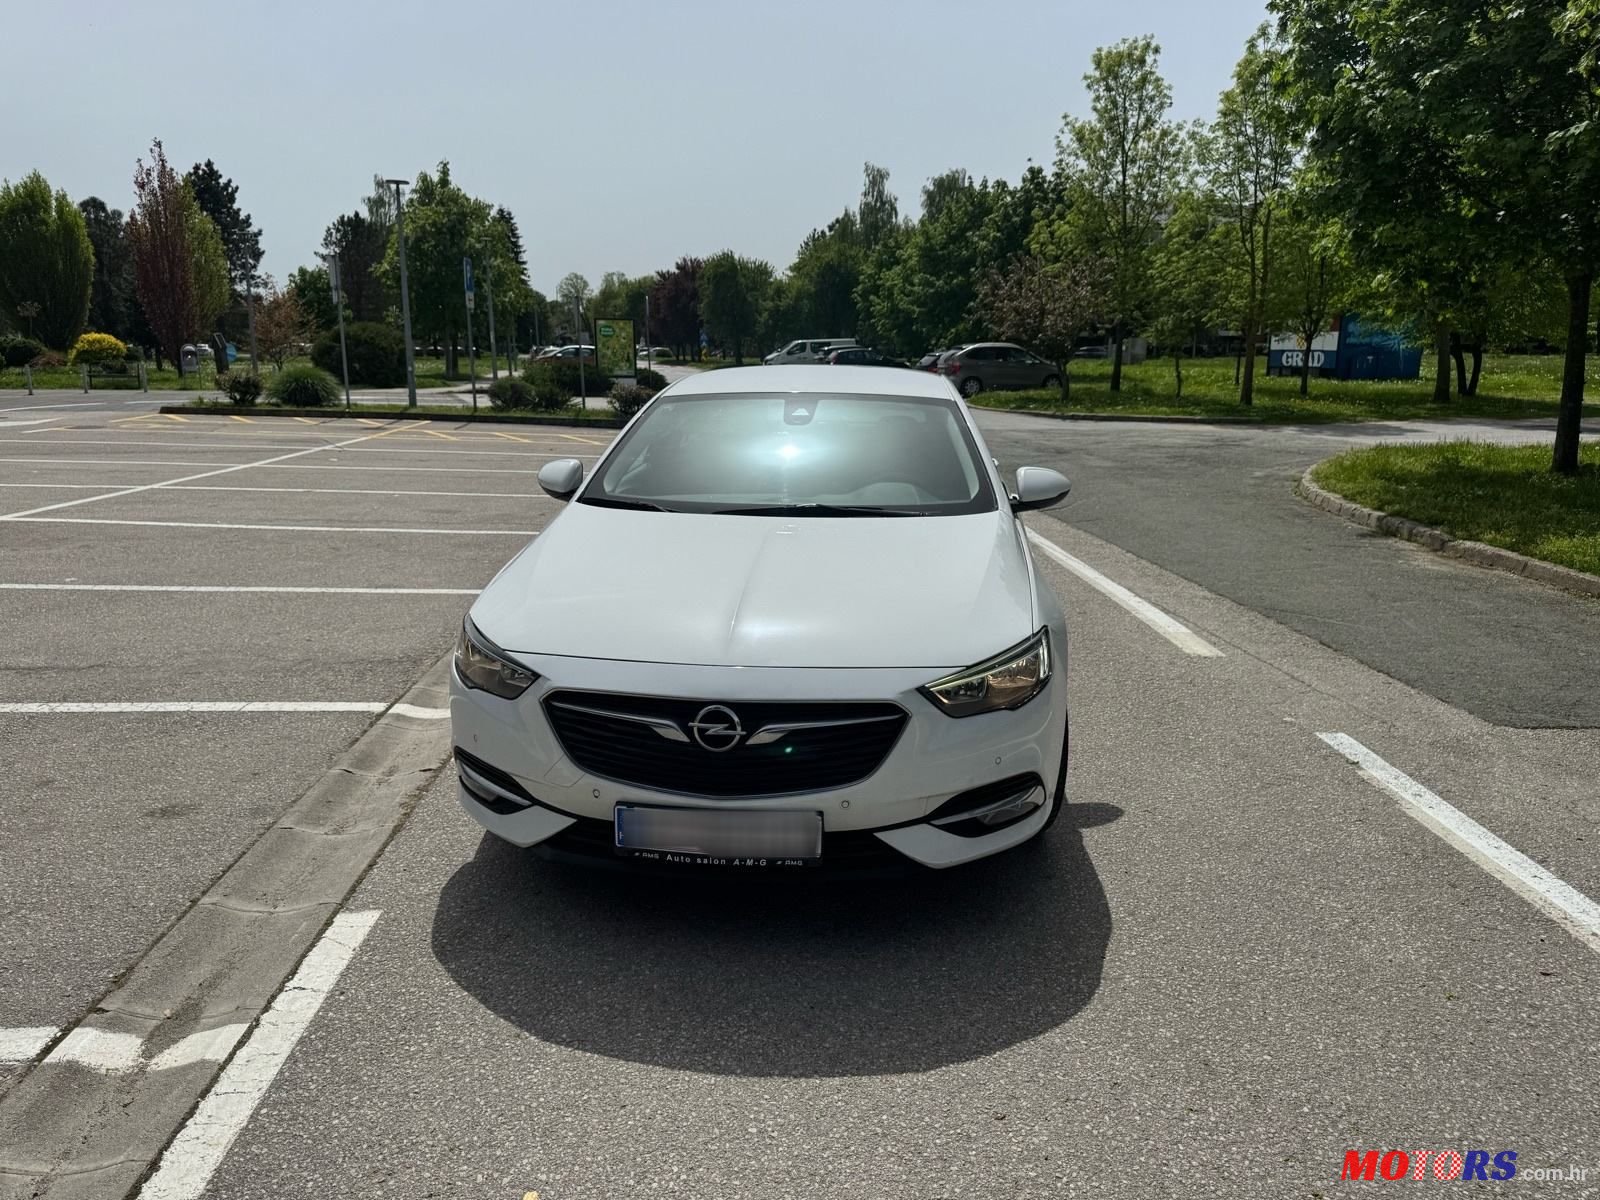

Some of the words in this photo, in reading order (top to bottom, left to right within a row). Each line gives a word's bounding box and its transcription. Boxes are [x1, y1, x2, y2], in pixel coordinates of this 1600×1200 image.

[666, 854, 691, 863] Auto
[696, 856, 726, 865] salon
[733, 858, 767, 866] A-M-G
